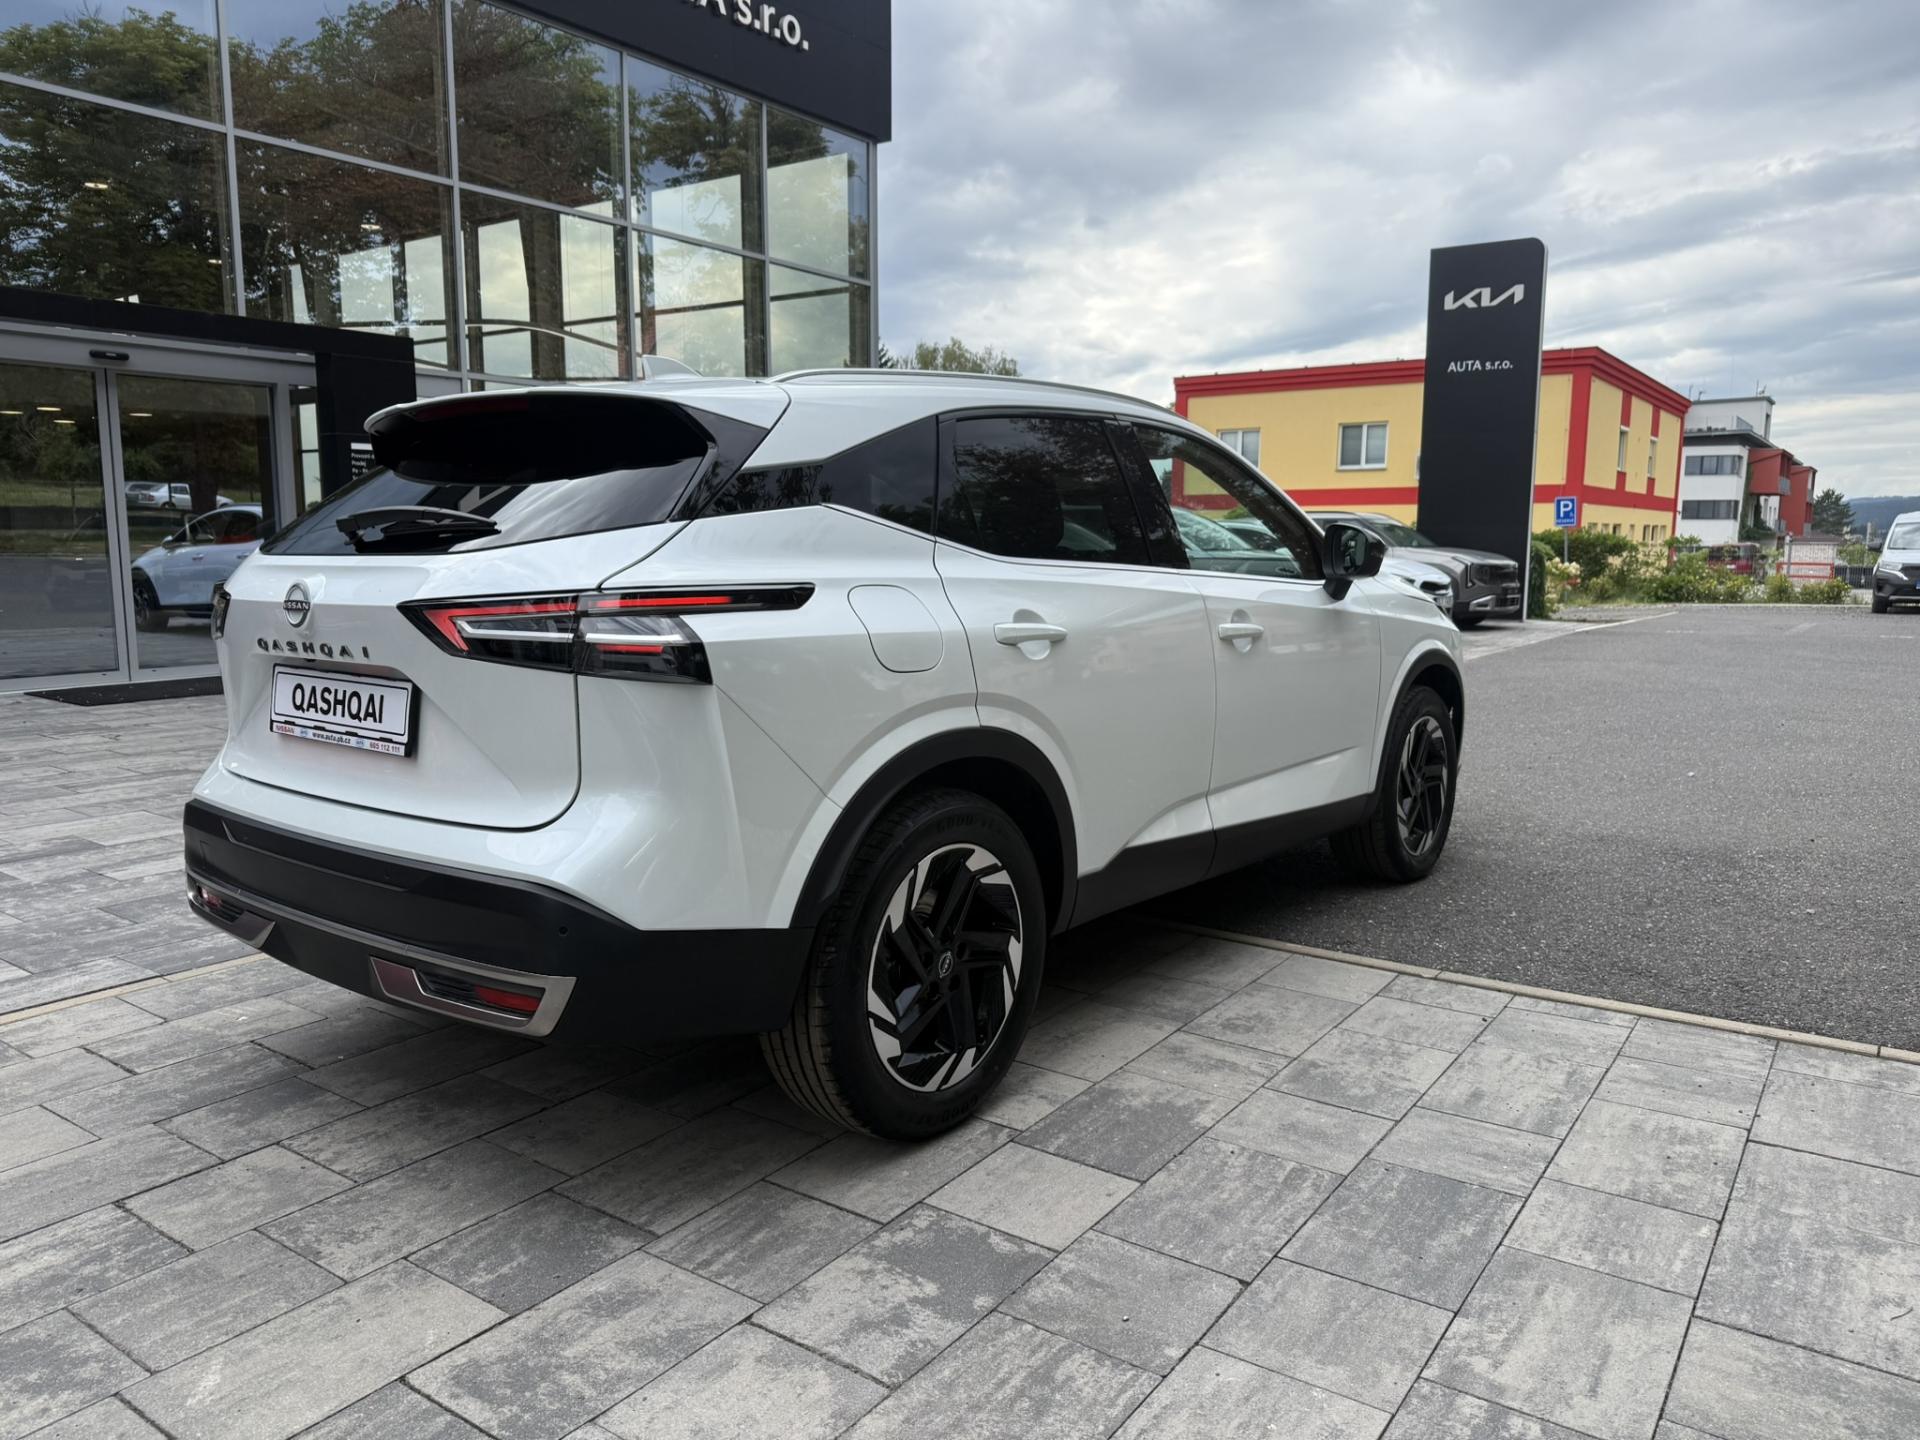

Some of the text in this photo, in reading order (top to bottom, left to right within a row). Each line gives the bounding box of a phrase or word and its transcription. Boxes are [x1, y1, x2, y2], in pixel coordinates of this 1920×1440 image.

[734, 0, 809, 50] s.r.o.
[1443, 283, 1525, 311] KIA
[1447, 359, 1513, 373] AUTA s.r.o.
[1560, 500, 1573, 518] P
[257, 637, 370, 659] QASHQAI
[291, 682, 385, 724] QASHQAI
